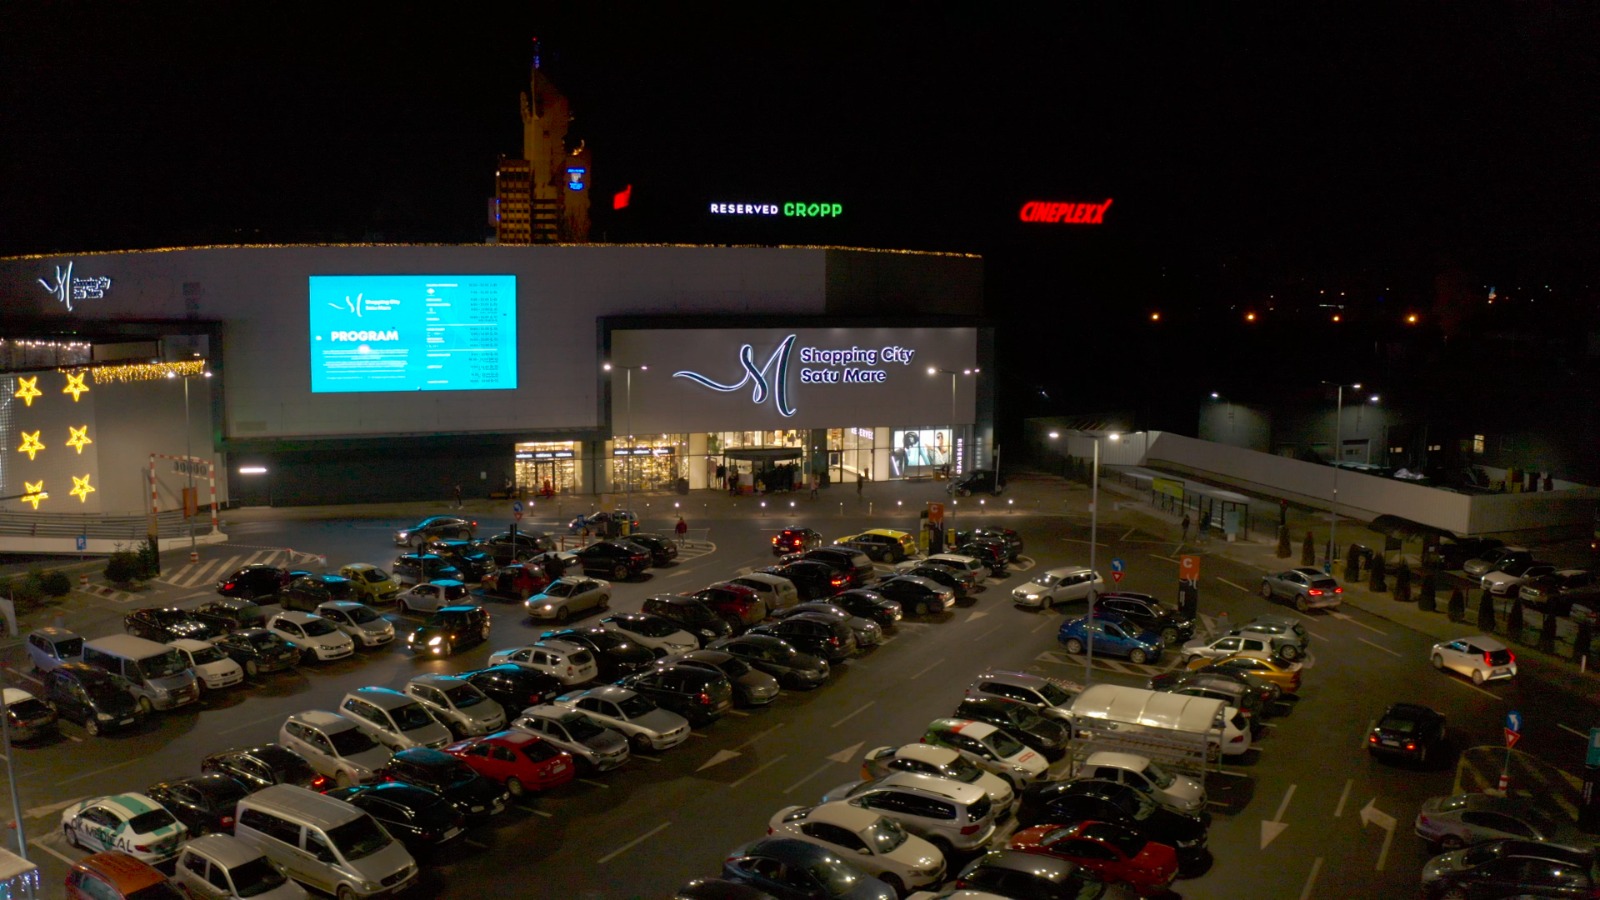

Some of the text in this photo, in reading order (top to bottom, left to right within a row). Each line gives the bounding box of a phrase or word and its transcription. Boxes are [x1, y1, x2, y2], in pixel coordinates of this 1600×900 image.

[710, 203, 779, 215] RESERVED
[783, 202, 843, 218] CROPP
[1020, 198, 1113, 225] CINEPLEXX
[331, 330, 399, 342] PROGRAM
[800, 346, 915, 366] Shopping City
[800, 367, 887, 384] Satu Mare
